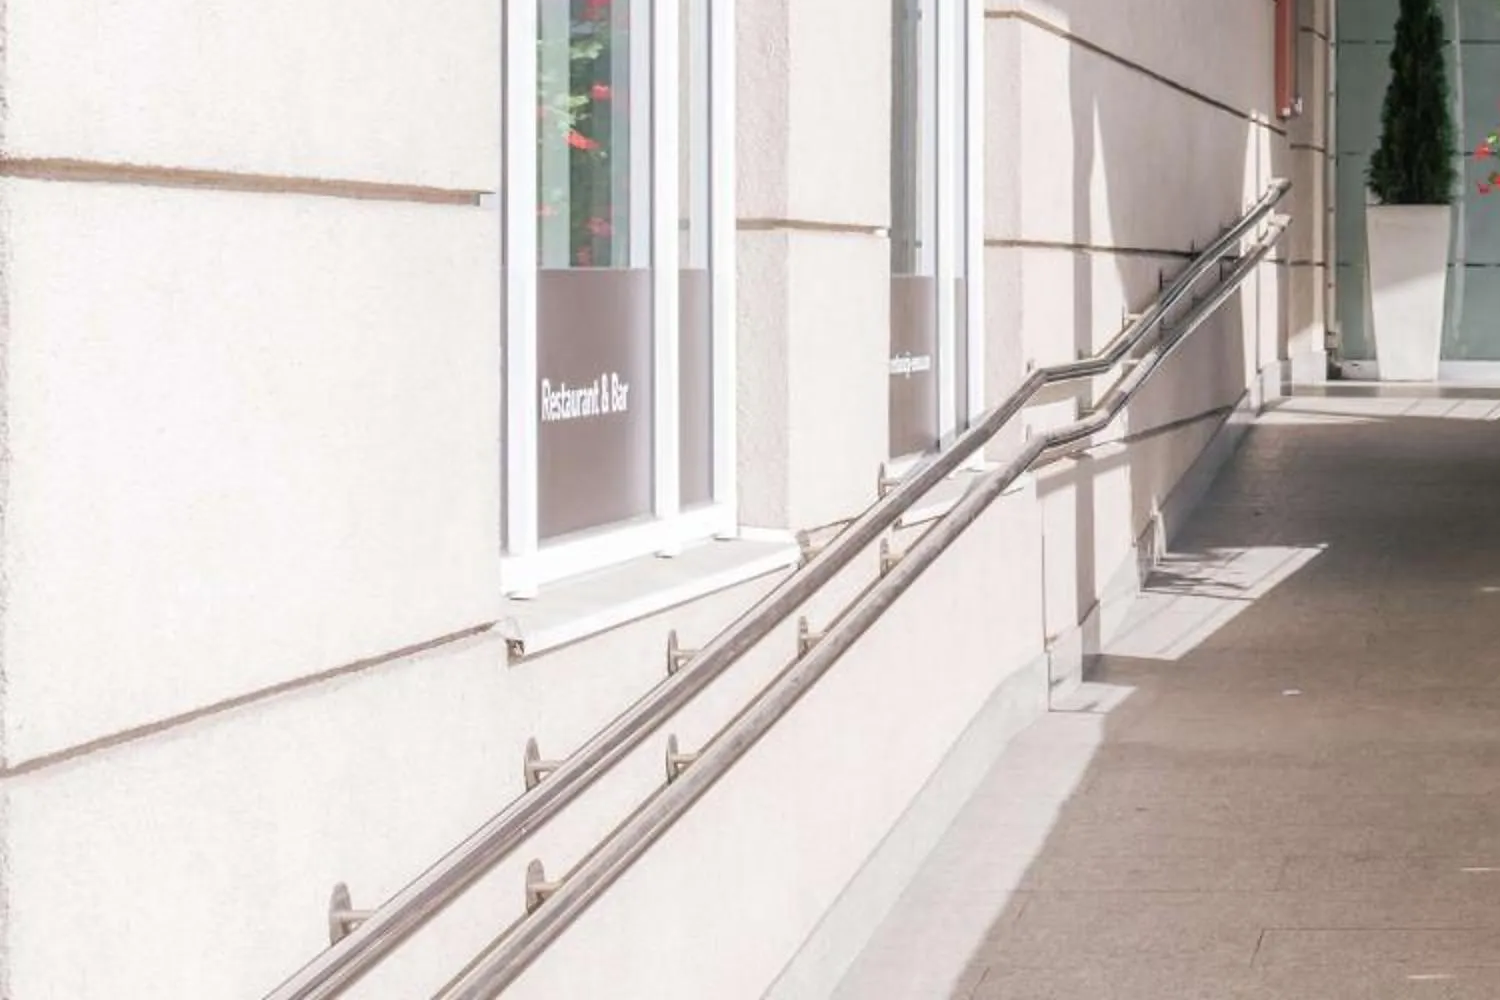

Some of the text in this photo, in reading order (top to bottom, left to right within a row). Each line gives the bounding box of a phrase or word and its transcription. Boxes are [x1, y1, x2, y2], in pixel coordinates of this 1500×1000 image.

[542, 372, 629, 421] Restaurant & Bar
